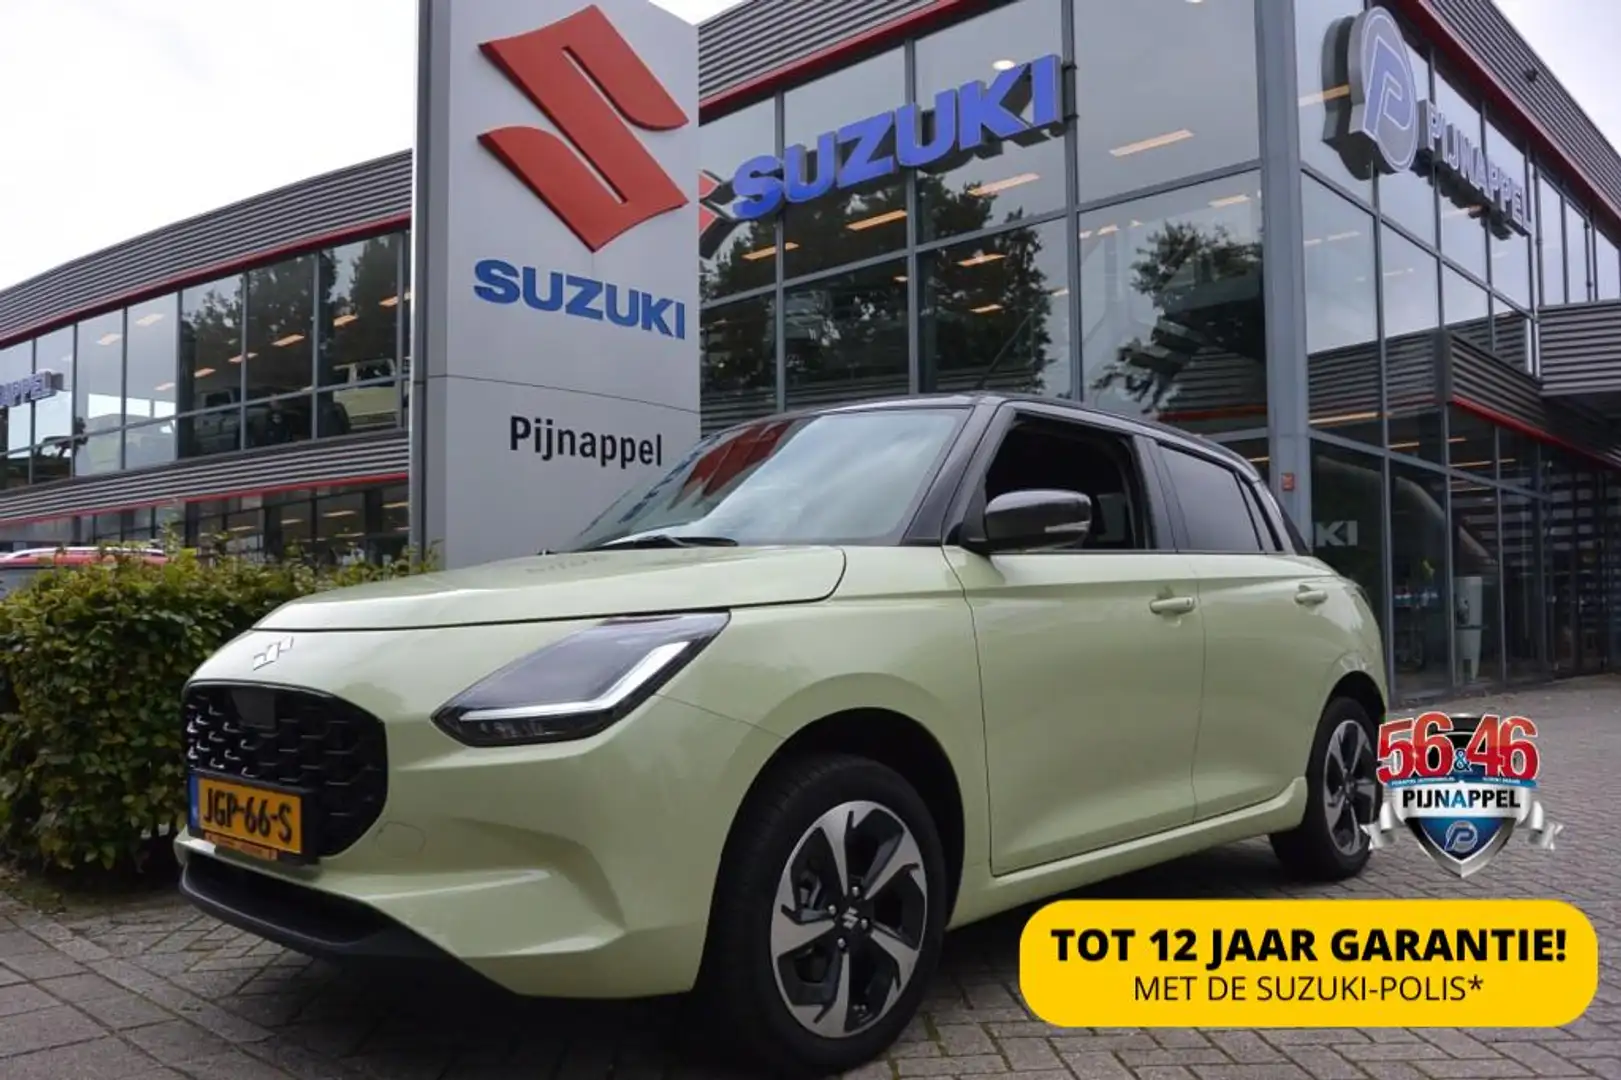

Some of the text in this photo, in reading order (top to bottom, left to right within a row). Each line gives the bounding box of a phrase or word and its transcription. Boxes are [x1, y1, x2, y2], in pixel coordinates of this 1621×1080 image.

[731, 54, 1062, 220] SUZUKI
[1426, 100, 1532, 236] PIJNAPPEL
[474, 259, 685, 340] SUZUKI
[509, 415, 662, 469] Pijnappel
[203, 788, 293, 844] JGP-66-S
